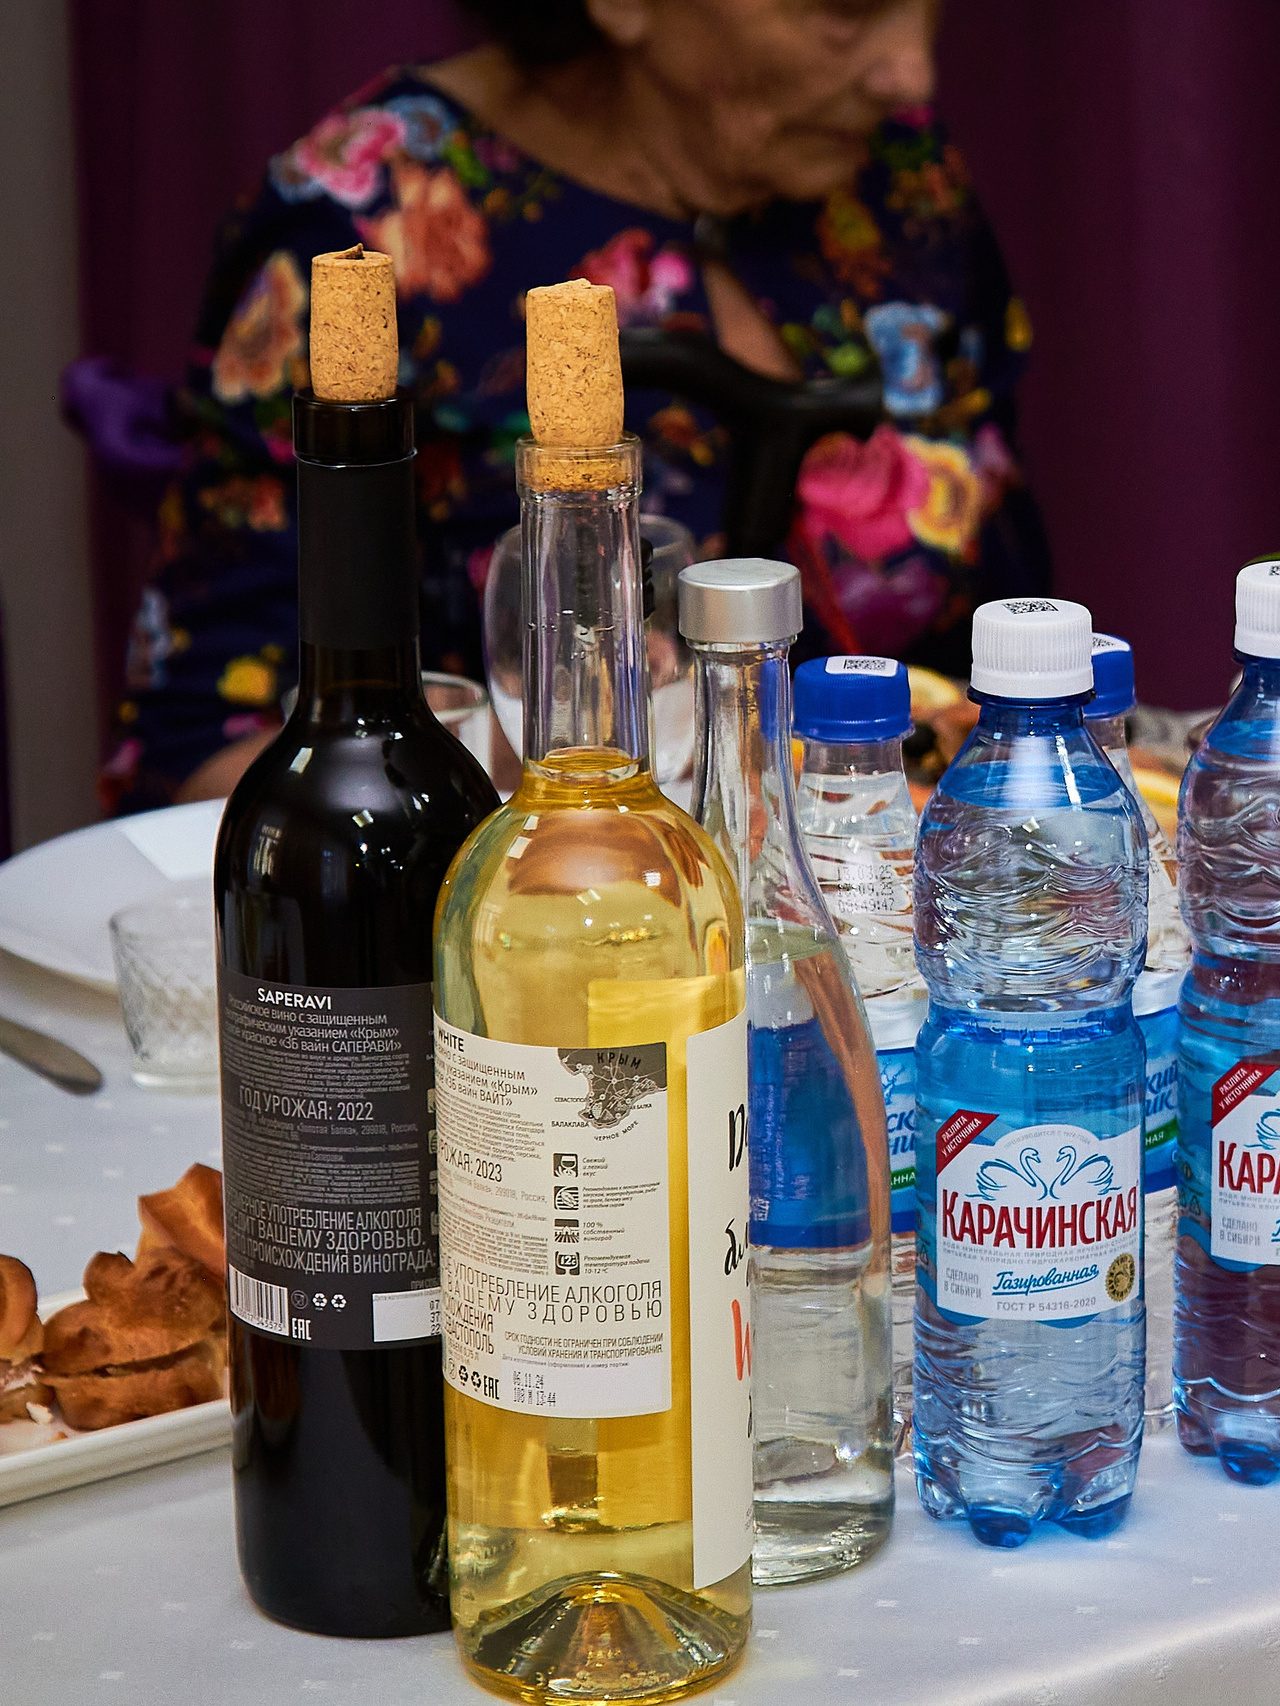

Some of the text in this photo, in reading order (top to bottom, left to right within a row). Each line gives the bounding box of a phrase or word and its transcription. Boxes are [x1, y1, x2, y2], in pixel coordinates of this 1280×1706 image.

[257, 987, 332, 1010] SAPERAVI
[271, 1008, 297, 1021] вино
[298, 1013, 305, 1023] с
[306, 1013, 388, 1027] защищенным
[289, 1024, 348, 1039] указанием
[350, 1027, 399, 1041] «Крым»
[438, 1028, 464, 1053] WHITE
[301, 1038, 330, 1053] вайн
[331, 1040, 402, 1053] САПЕРАВИ»
[458, 1055, 526, 1081] защищенным
[597, 1052, 642, 1070] КРЫМ
[446, 1063, 489, 1089] указанием
[491, 1079, 538, 1096] «Крым»
[1218, 1067, 1248, 1096] РАЗЛИТА
[1218, 1069, 1263, 1111] У ИСТОЧНИКА
[240, 1085, 262, 1114] ГОД
[263, 1092, 333, 1121] УРОЖАЯ:
[337, 1101, 374, 1121] 2022
[458, 1083, 478, 1100] вайн
[480, 1089, 513, 1107] ВАЙТ»
[551, 1120, 590, 1128] БАЛАКЛАВА
[622, 1120, 639, 1134] МОРЕ
[941, 1115, 968, 1143] РАЗЛИТА
[941, 1117, 982, 1158] У ИСТОЧНИКА
[476, 1158, 503, 1183] 2023
[268, 1203, 355, 1231] УПОТРЕБЛЕНИЕ
[355, 1207, 422, 1231] АЛКОГОЛЯ
[941, 1186, 1137, 1249] КАРАЧИНСКАЯ
[1221, 1216, 1258, 1232] СДЕЛАНО
[258, 1219, 323, 1249] ВАШЕМУ
[326, 1227, 426, 1254] ЗДОРОВЬЮ.
[1219, 1229, 1260, 1246] В СИБИРИ
[247, 1237, 349, 1276] ПРОИСХОЖДЕНИЯ
[353, 1248, 437, 1274] ВИНОГРАДА:
[942, 1241, 960, 1250] ВОДА
[962, 1245, 1021, 1257] МИНЕРАЛЬНАЯ
[1024, 1249, 1074, 1258] ПРИРОДНАЯ
[454, 1260, 560, 1303] УПОТРЕБЛЕНИЕ
[564, 1279, 662, 1304] АЛКОГОЛЯ
[945, 1267, 979, 1285] СДЕЛАНО
[992, 1263, 1100, 1296] Газированная
[447, 1273, 663, 1326] ВАШЕМУ ЗДОРОВЬЮ
[943, 1281, 982, 1299] В СИБИРИ
[996, 1297, 1097, 1312] ГОСТ Р 54316-2020
[291, 1317, 312, 1341] EAC
[504, 1331, 664, 1349] СРОК ГОДНОСТИ НЕ ОГРАНИЧЕН ПРИ СОБЛЮДЕНИИ
[518, 1343, 663, 1360] УСЛОВИЙ ХРАНЕНИЯ И ТРАНСПОРТИРОВАНИЯ.
[483, 1375, 500, 1400] EAC
